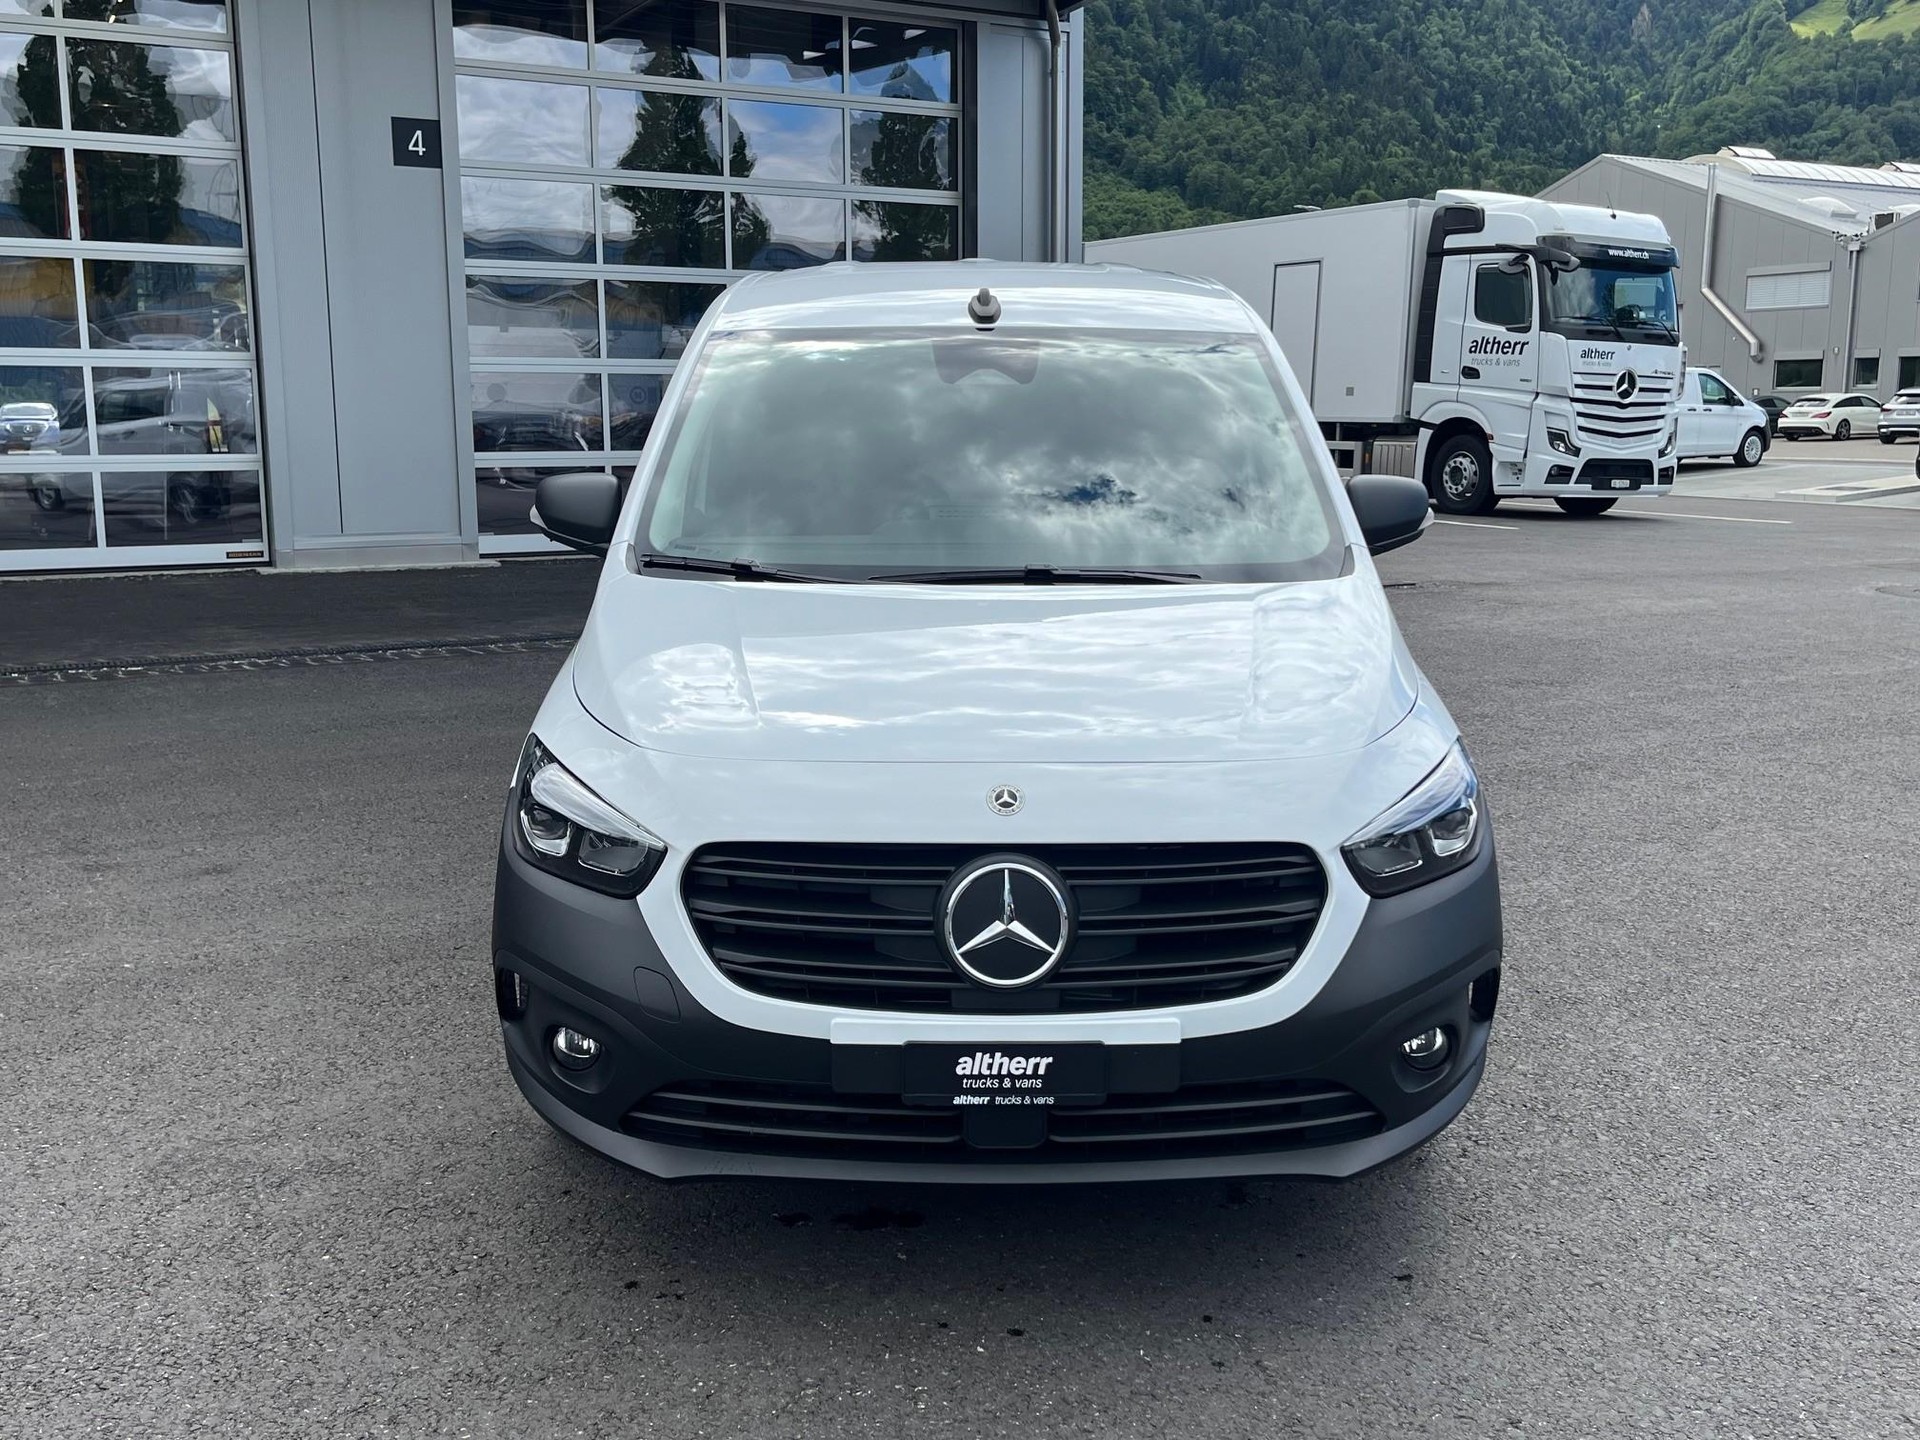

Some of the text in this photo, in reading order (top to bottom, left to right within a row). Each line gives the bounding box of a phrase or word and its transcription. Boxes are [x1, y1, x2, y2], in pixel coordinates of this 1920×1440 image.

[408, 130, 426, 156] 4
[1607, 248, 1650, 260] www.altherr.ch
[1468, 336, 1530, 355] altherr
[1580, 347, 1616, 360] altherr
[1471, 358, 1521, 367] trucks & vans
[955, 1052, 1053, 1075] altherr
[962, 1077, 1043, 1088] trucks & vans
[953, 1095, 1055, 1105] altherr trucks & vans
